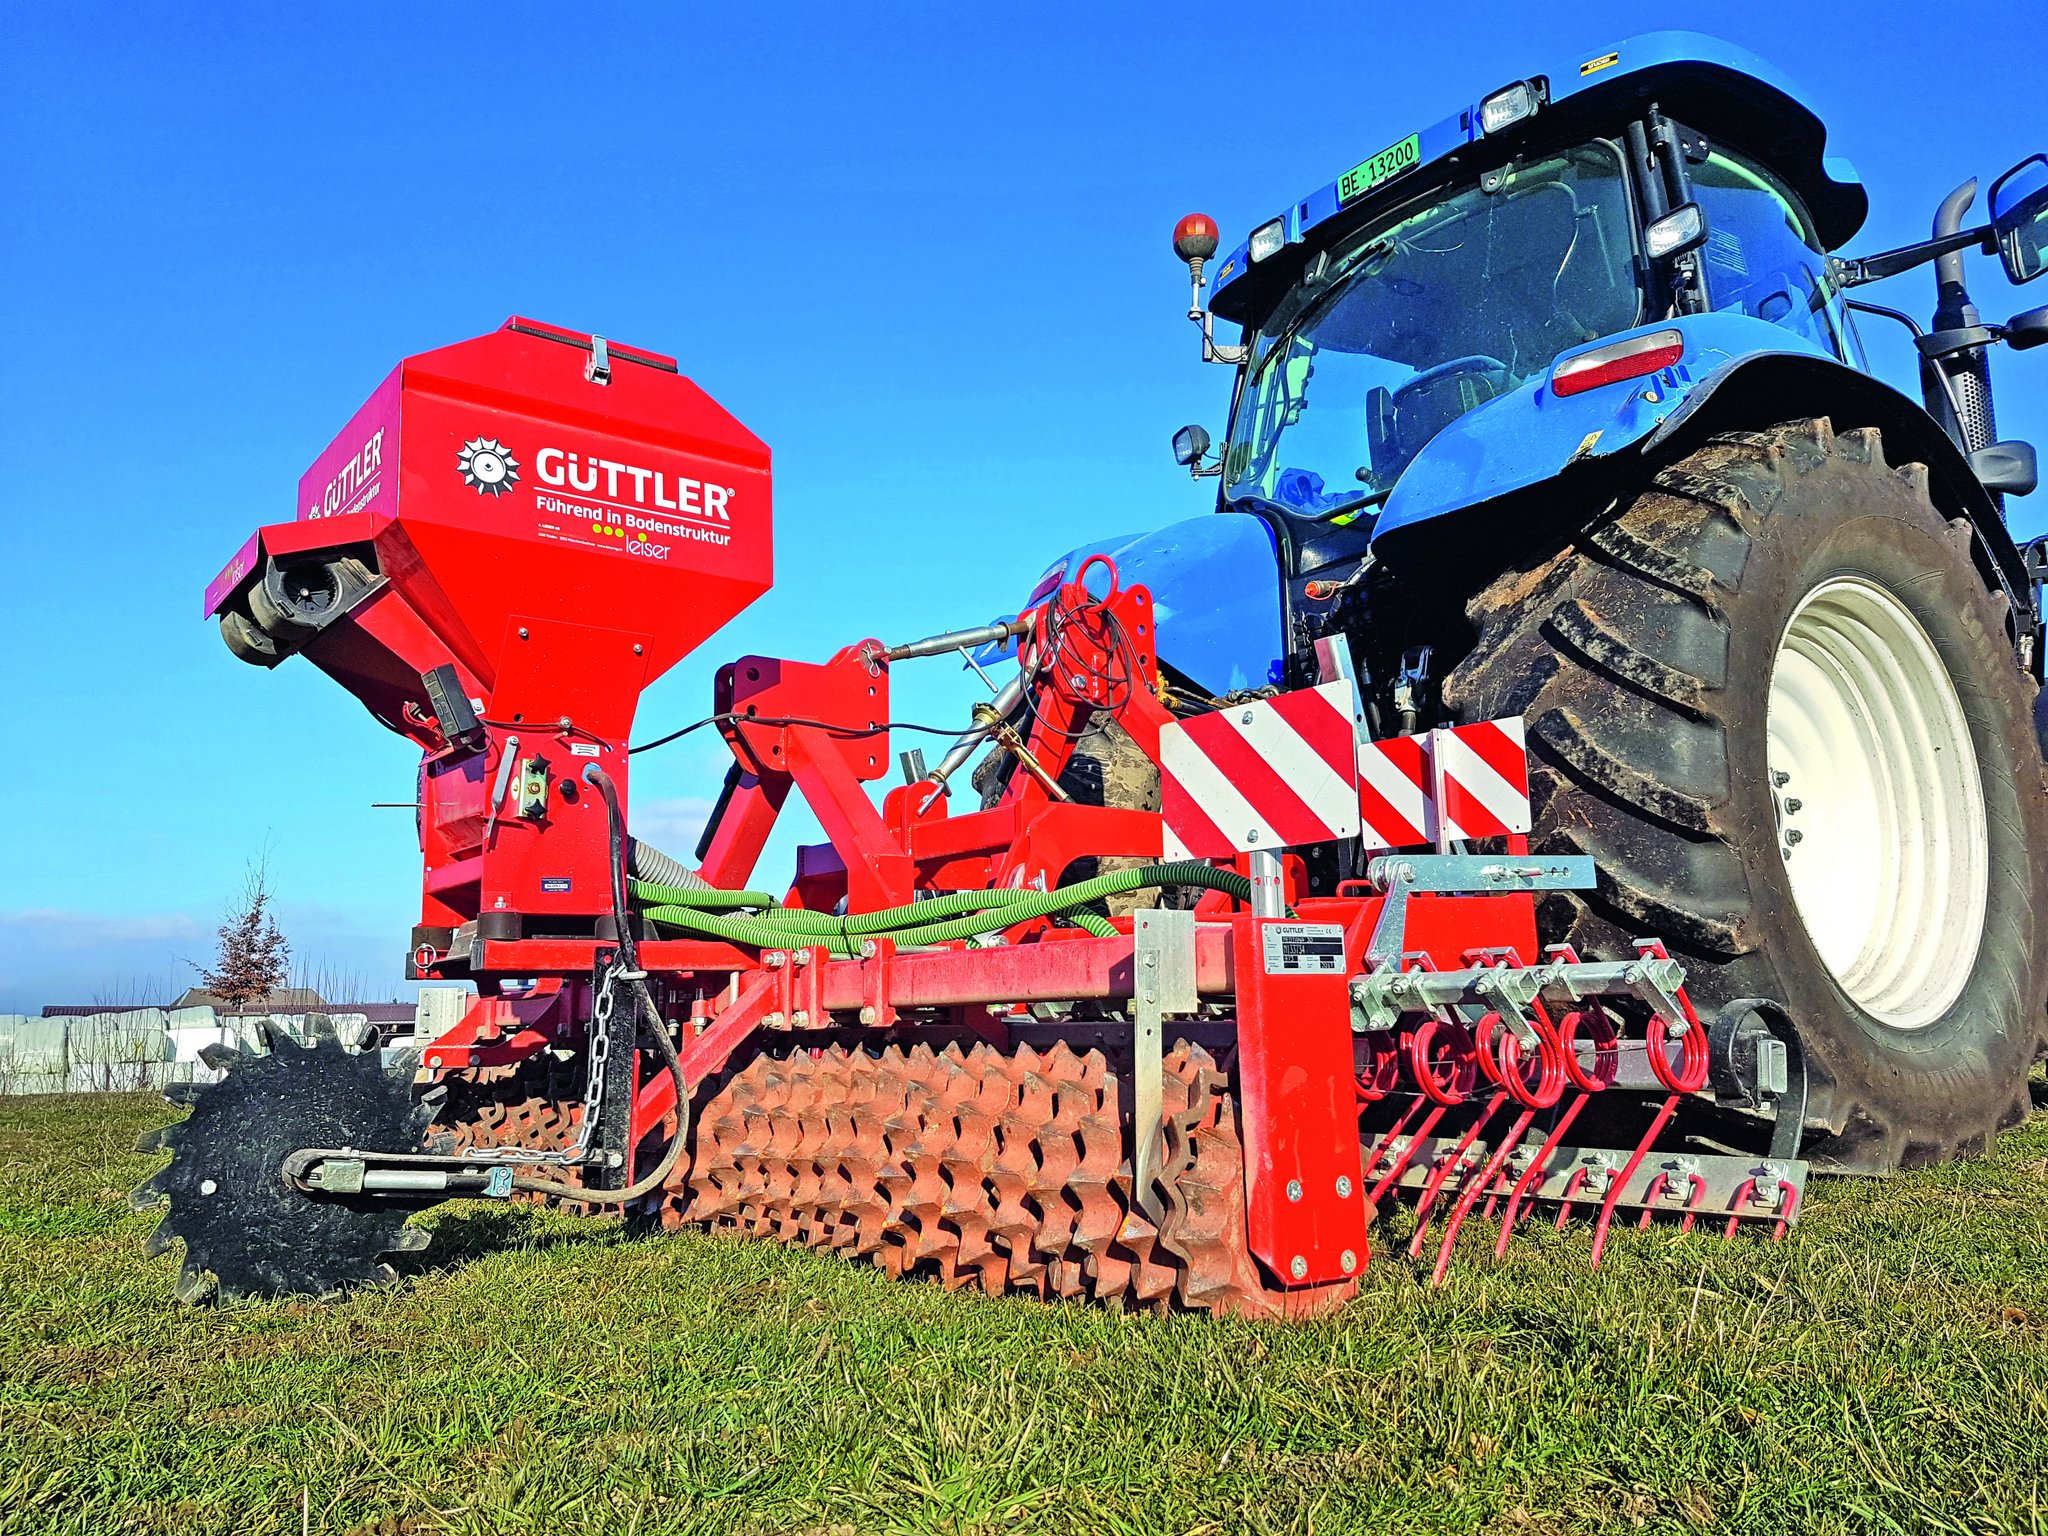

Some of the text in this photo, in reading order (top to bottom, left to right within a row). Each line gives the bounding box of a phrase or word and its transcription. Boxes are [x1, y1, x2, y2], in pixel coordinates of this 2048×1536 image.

[536, 496, 731, 546] Führend in Bodenstruktur
[626, 533, 671, 560] leiser
[1283, 926, 1304, 934] GÜTTLER
